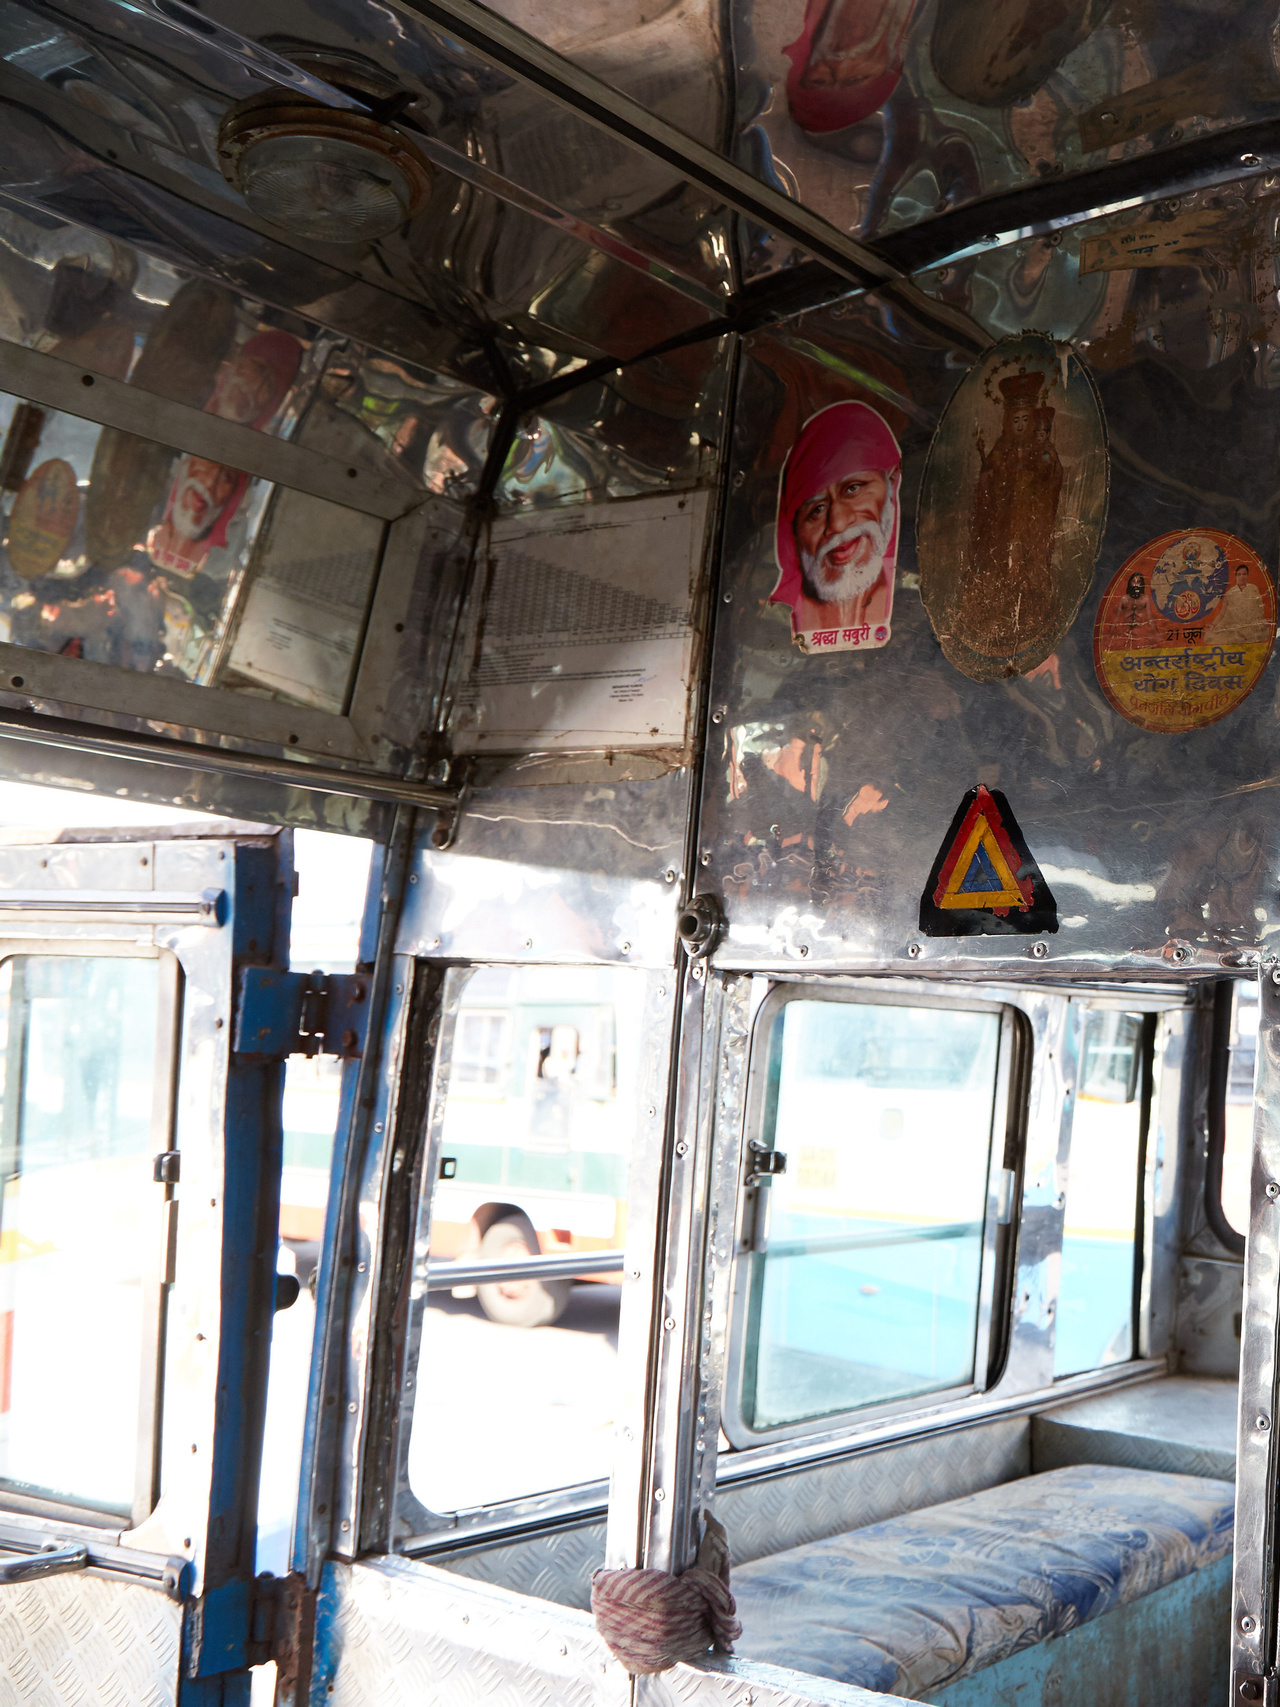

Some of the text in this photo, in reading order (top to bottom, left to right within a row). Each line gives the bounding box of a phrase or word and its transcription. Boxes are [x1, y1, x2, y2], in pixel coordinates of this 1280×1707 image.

[811, 630, 840, 646] श्रद्धा
[1166, 626, 1204, 644] 21 जून
[1133, 670, 1246, 693] योग दिवस
